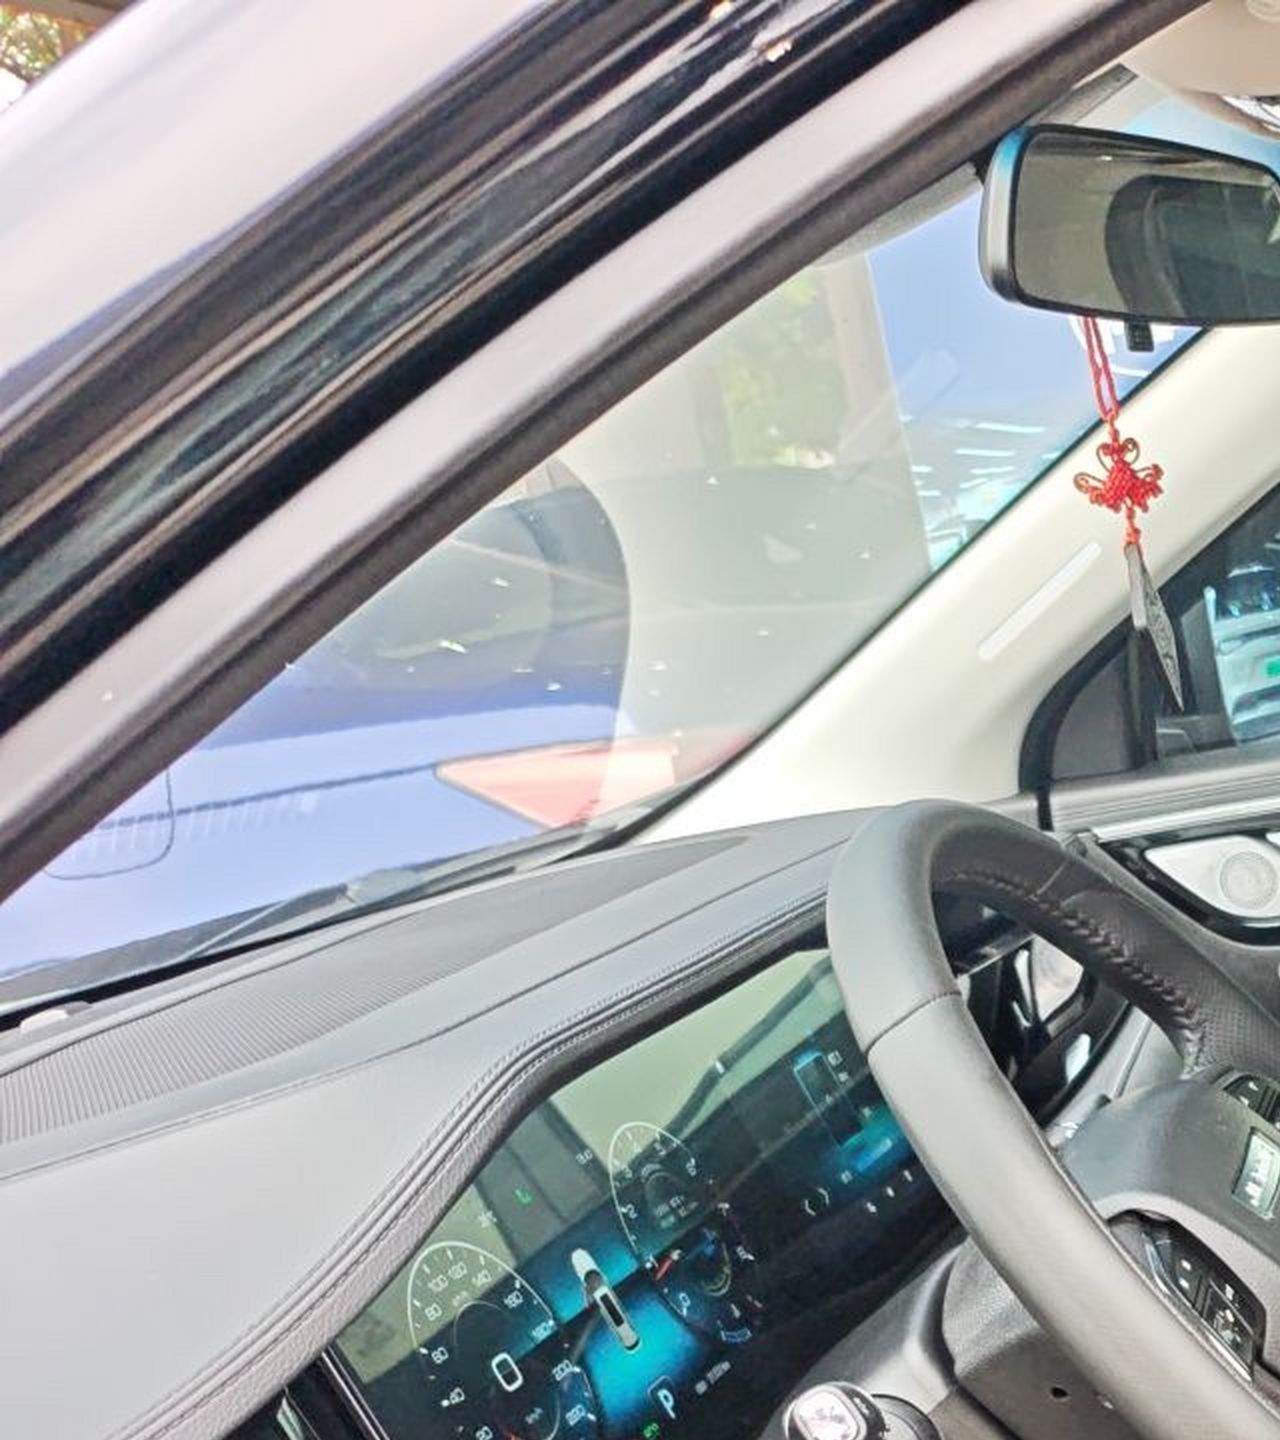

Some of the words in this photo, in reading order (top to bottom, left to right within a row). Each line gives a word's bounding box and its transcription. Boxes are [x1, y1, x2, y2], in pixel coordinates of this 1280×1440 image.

[428, 1275, 449, 1292] 100
[491, 1352, 523, 1392] 0
[657, 1388, 677, 1419] P
